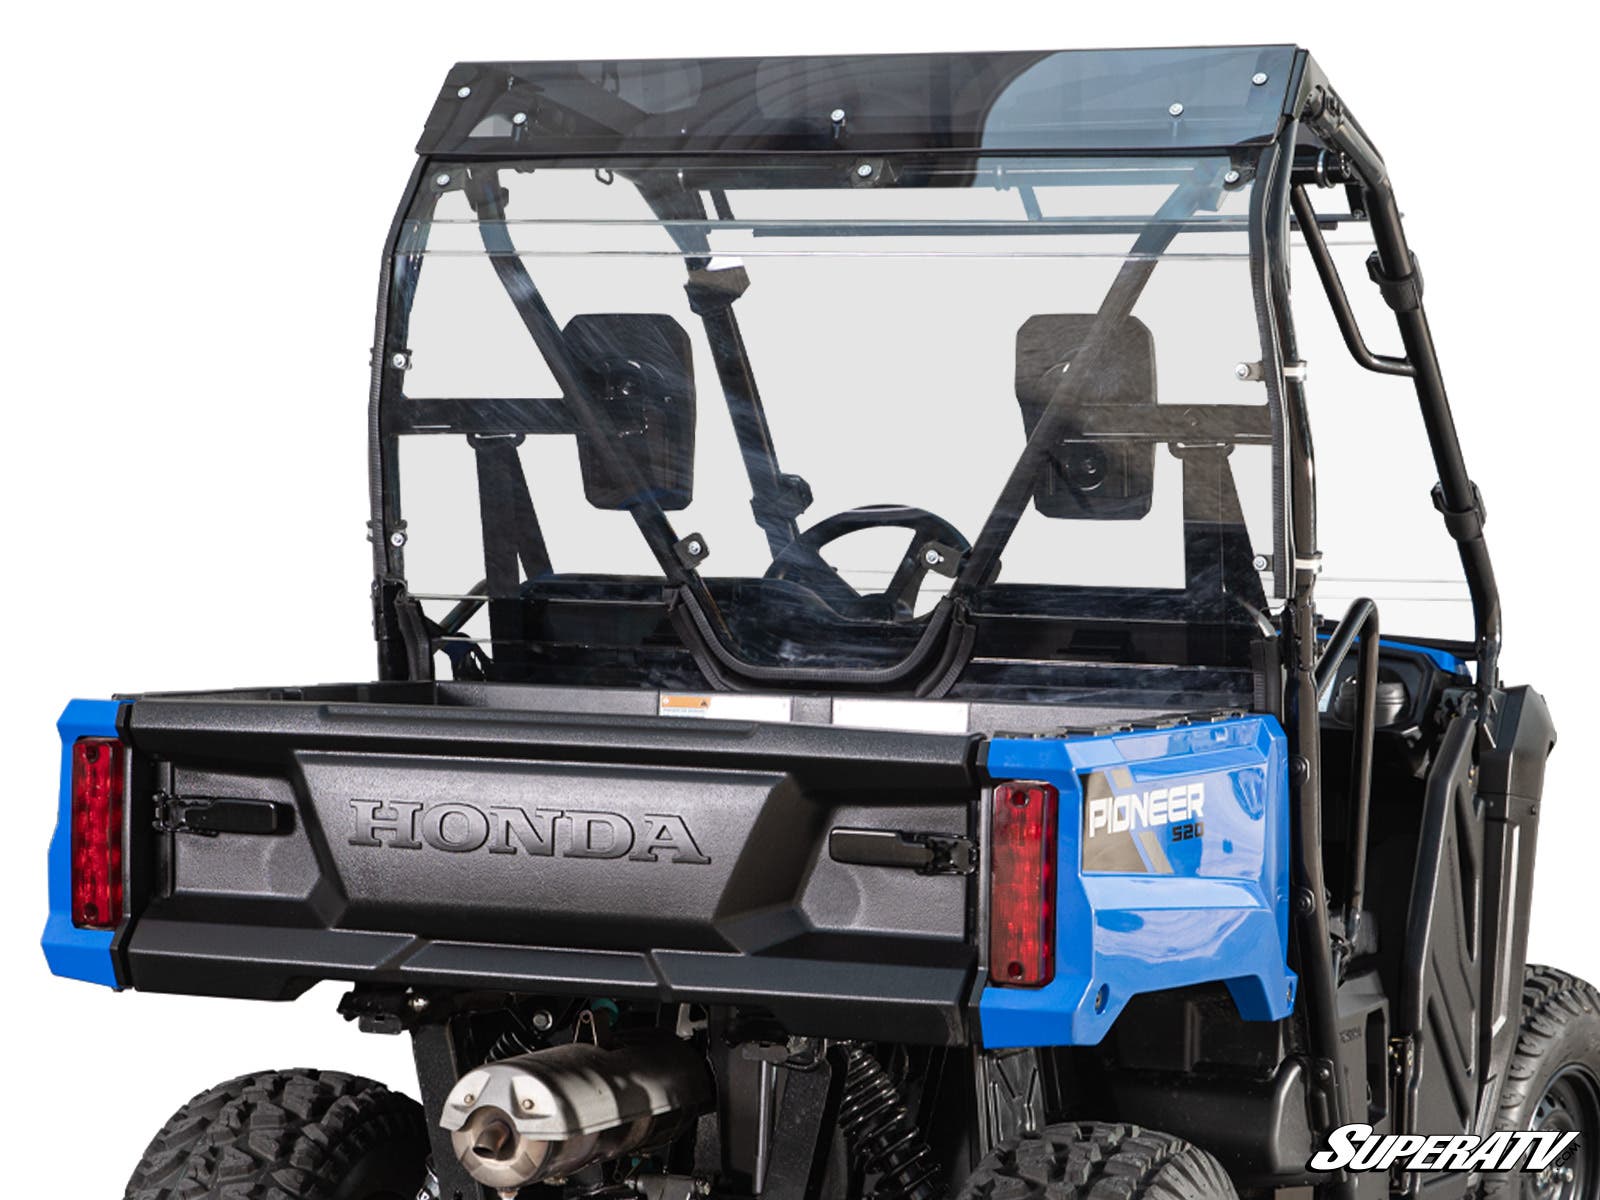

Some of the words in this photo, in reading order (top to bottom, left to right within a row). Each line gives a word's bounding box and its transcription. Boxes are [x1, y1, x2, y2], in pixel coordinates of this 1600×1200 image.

[348, 798, 712, 865] HONDA
[1089, 782, 1206, 838] PIONEER
[1171, 822, 1205, 842] 520
